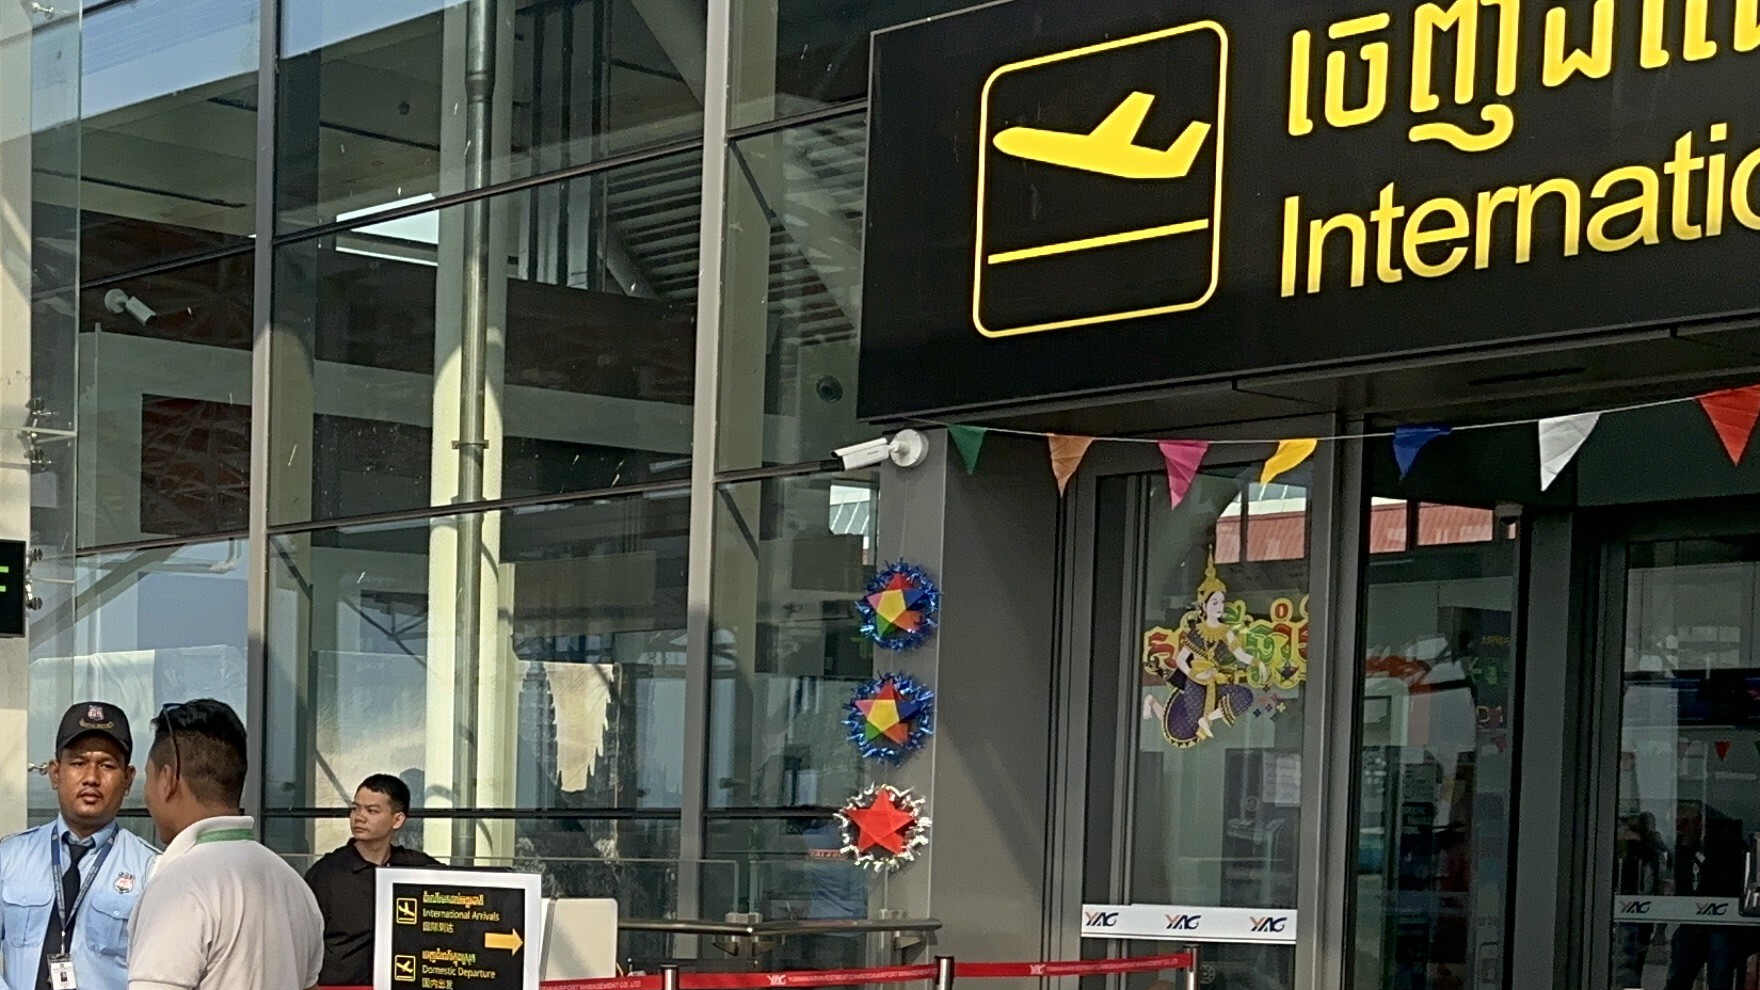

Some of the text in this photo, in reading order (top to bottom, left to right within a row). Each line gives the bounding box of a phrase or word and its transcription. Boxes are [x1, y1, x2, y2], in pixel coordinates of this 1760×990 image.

[422, 908, 500, 922] International Arrivals
[422, 964, 496, 980] Domestic Departure
